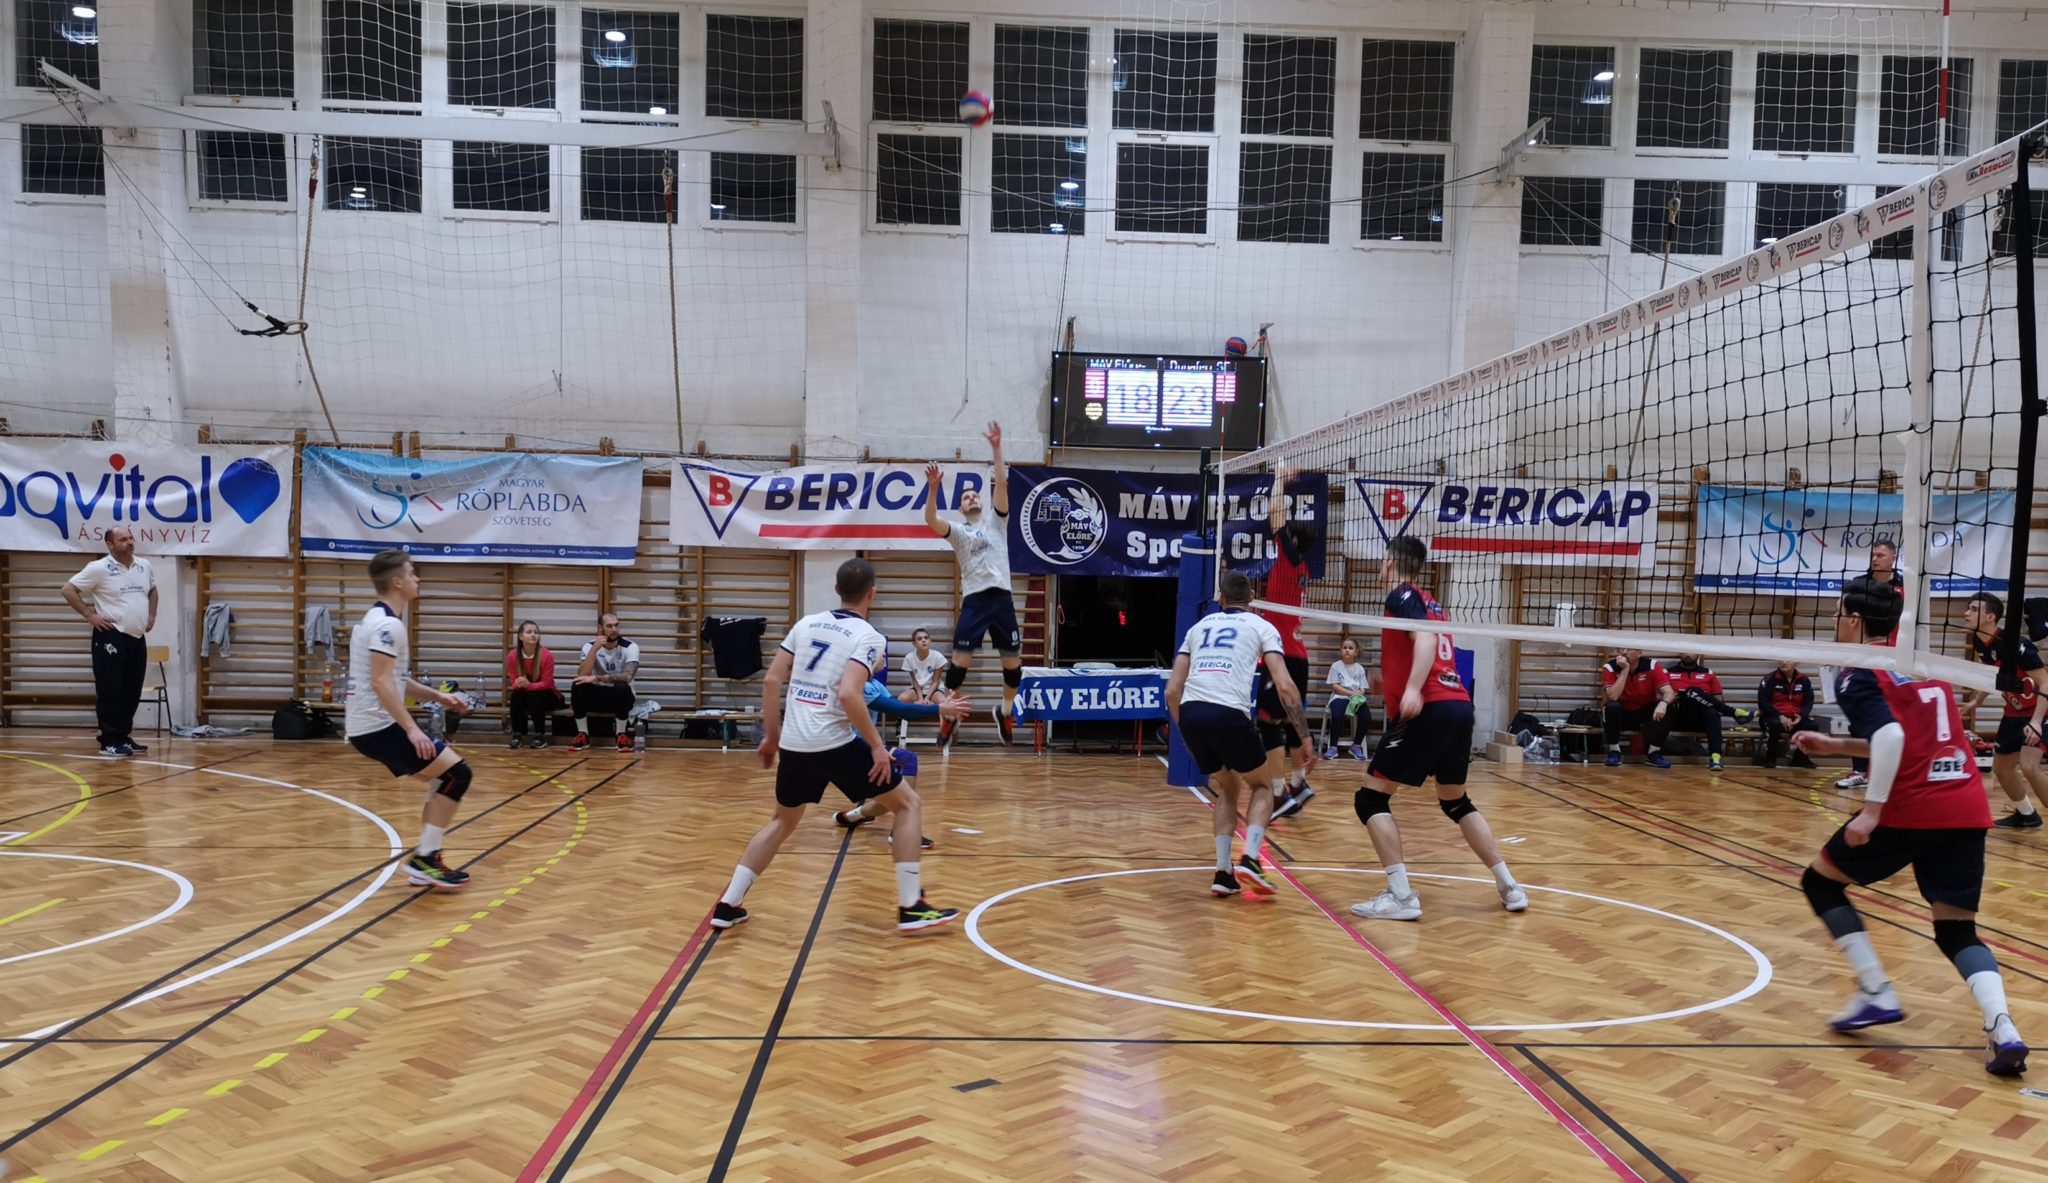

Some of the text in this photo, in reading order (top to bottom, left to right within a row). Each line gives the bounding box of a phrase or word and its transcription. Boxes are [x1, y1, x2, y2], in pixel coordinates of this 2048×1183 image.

[1889, 194, 1915, 215] BERICA
[1796, 233, 1823, 251] BERICAP
[1115, 384, 1152, 414] 18
[1168, 384, 1207, 414] 23
[498, 478, 545, 489] MAGYAR
[708, 474, 734, 507] B
[764, 470, 983, 511] BERICAP
[456, 488, 587, 513] RÖPLABDA
[1118, 486, 1193, 521] MÁV
[1382, 487, 1408, 521] B
[1437, 485, 1651, 528] BERICAP
[78, 522, 210, 544] ÁSÁNYVÍZ
[492, 514, 552, 527] SZÖVETSÉG
[1070, 521, 1090, 531] MÁV
[1126, 530, 1279, 564] Spo Clu
[1840, 527, 1964, 549] RÖPLDA
[1198, 627, 1239, 650] 12
[804, 638, 833, 672] 7
[1198, 661, 1233, 669] BERICAP
[796, 689, 829, 701] BERICAP
[1071, 680, 1160, 711] ELŐRE
[1917, 686, 1952, 743] 7
